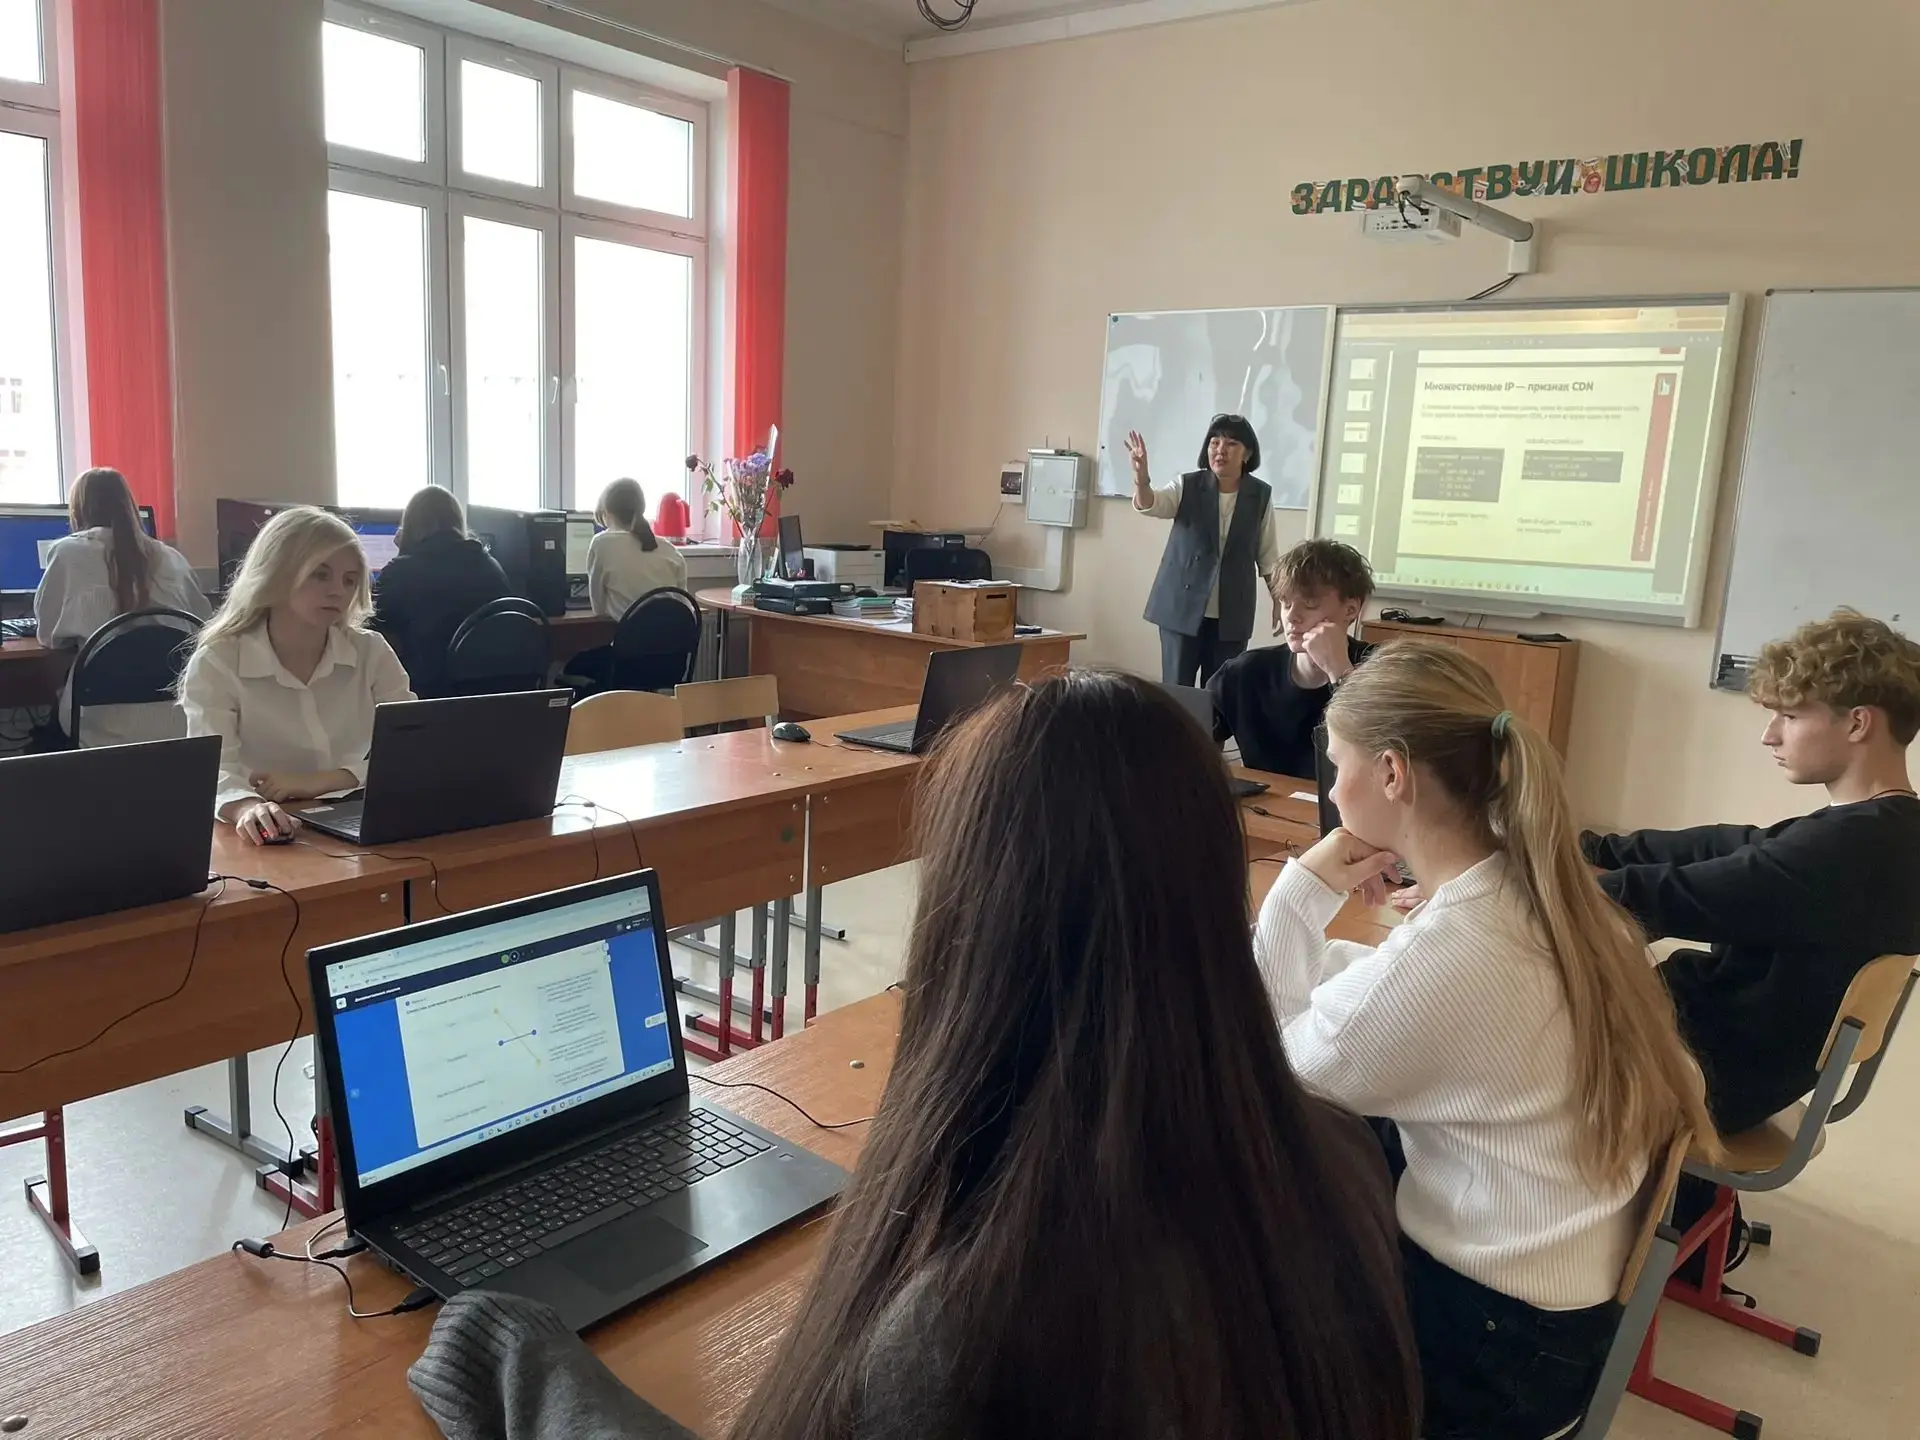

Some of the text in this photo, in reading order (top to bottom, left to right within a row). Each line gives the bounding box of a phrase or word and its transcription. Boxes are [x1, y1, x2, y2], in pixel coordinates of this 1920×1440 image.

[1605, 139, 1803, 192] ШКОЛА!
[1424, 381, 1503, 392] Множественные
[1504, 381, 1515, 391] IP
[1528, 382, 1569, 393] признак
[1572, 381, 1594, 391] CDN
